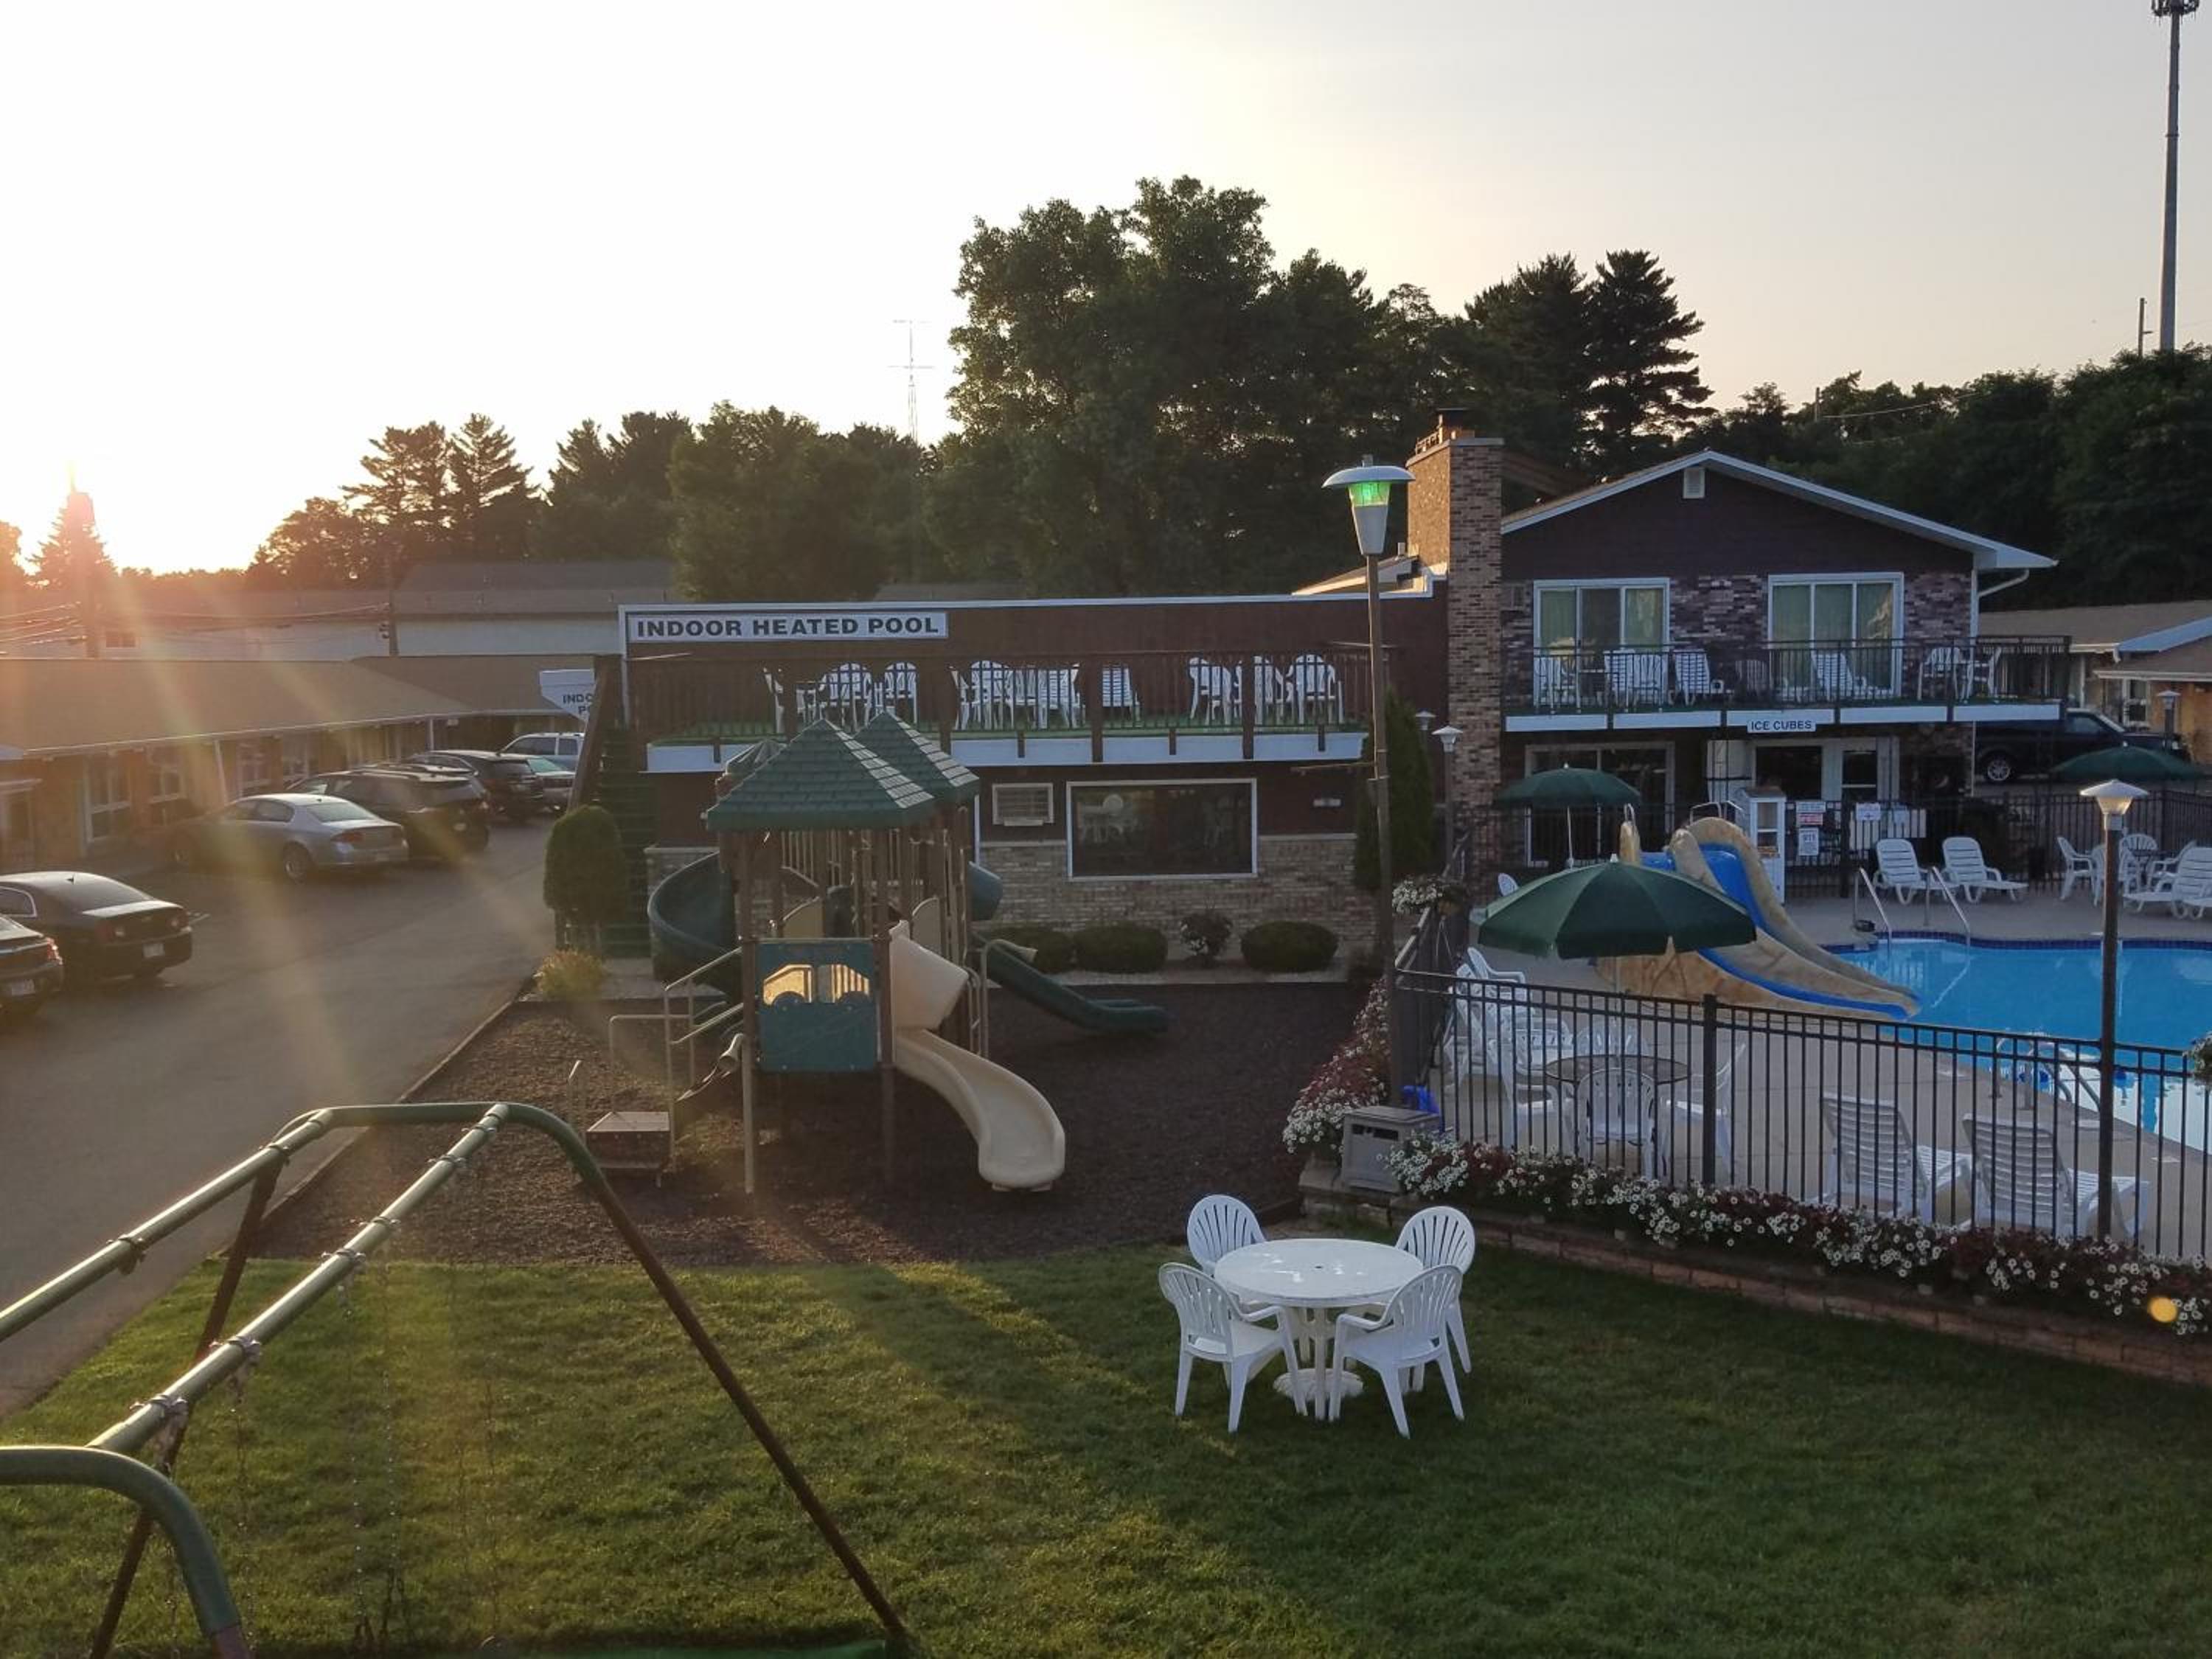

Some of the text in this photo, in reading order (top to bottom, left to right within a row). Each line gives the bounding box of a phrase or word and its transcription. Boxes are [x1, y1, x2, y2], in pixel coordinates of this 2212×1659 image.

[637, 618, 939, 637] INDOOR HEATED POOL
[1751, 720, 1812, 731] ICE CUBES
